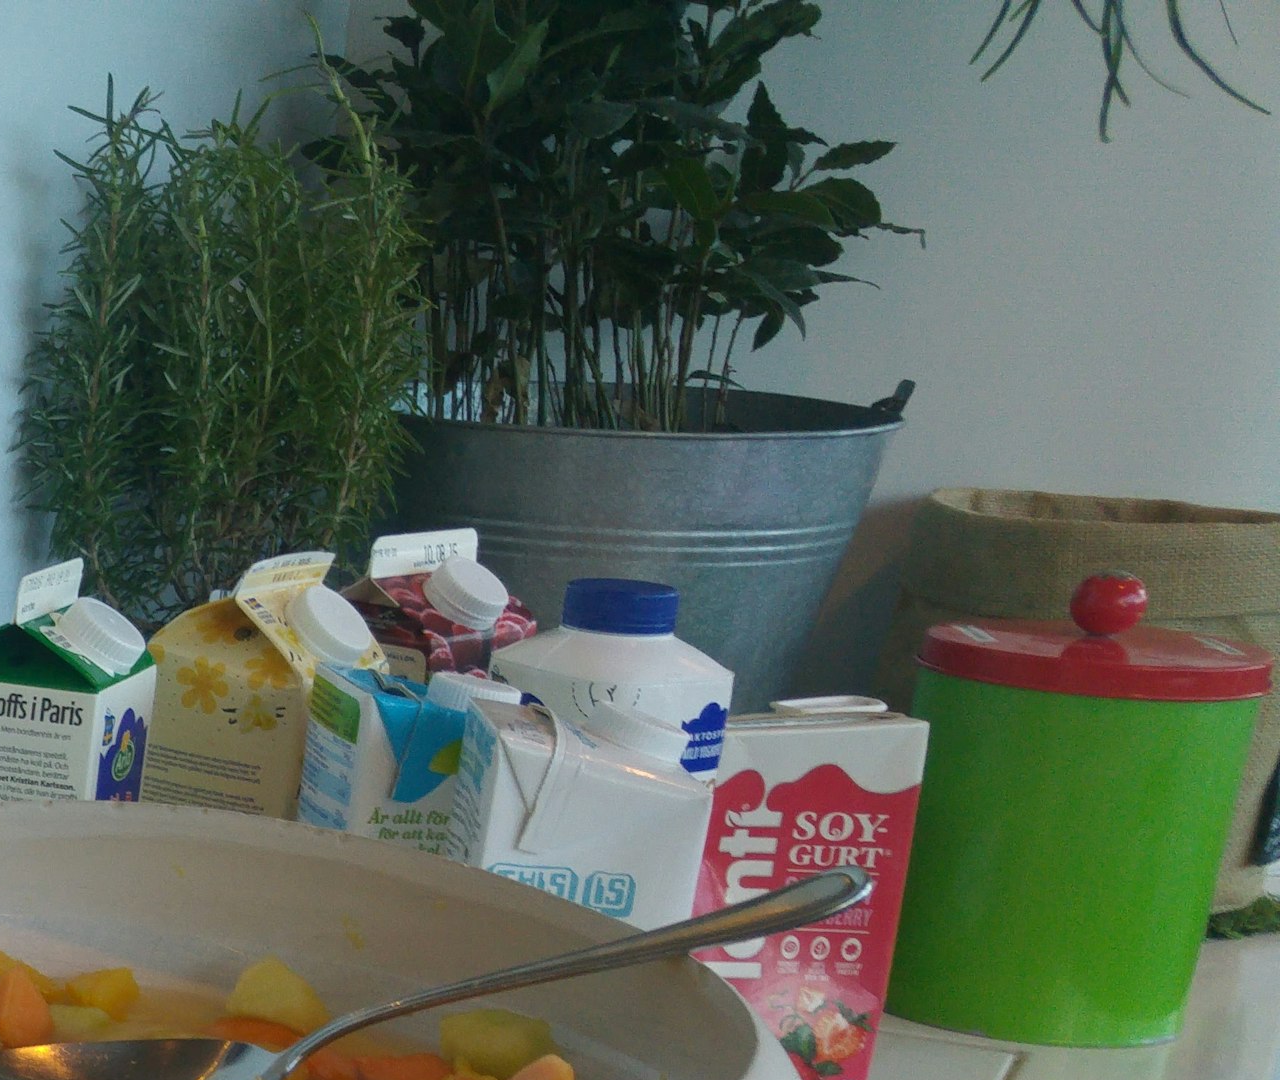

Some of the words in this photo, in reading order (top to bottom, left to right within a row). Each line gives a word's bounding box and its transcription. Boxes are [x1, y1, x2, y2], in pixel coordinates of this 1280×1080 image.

[31, 696, 37, 721] i
[40, 697, 84, 727] Paris
[792, 811, 890, 843] SOY-
[789, 843, 884, 869] GURT
